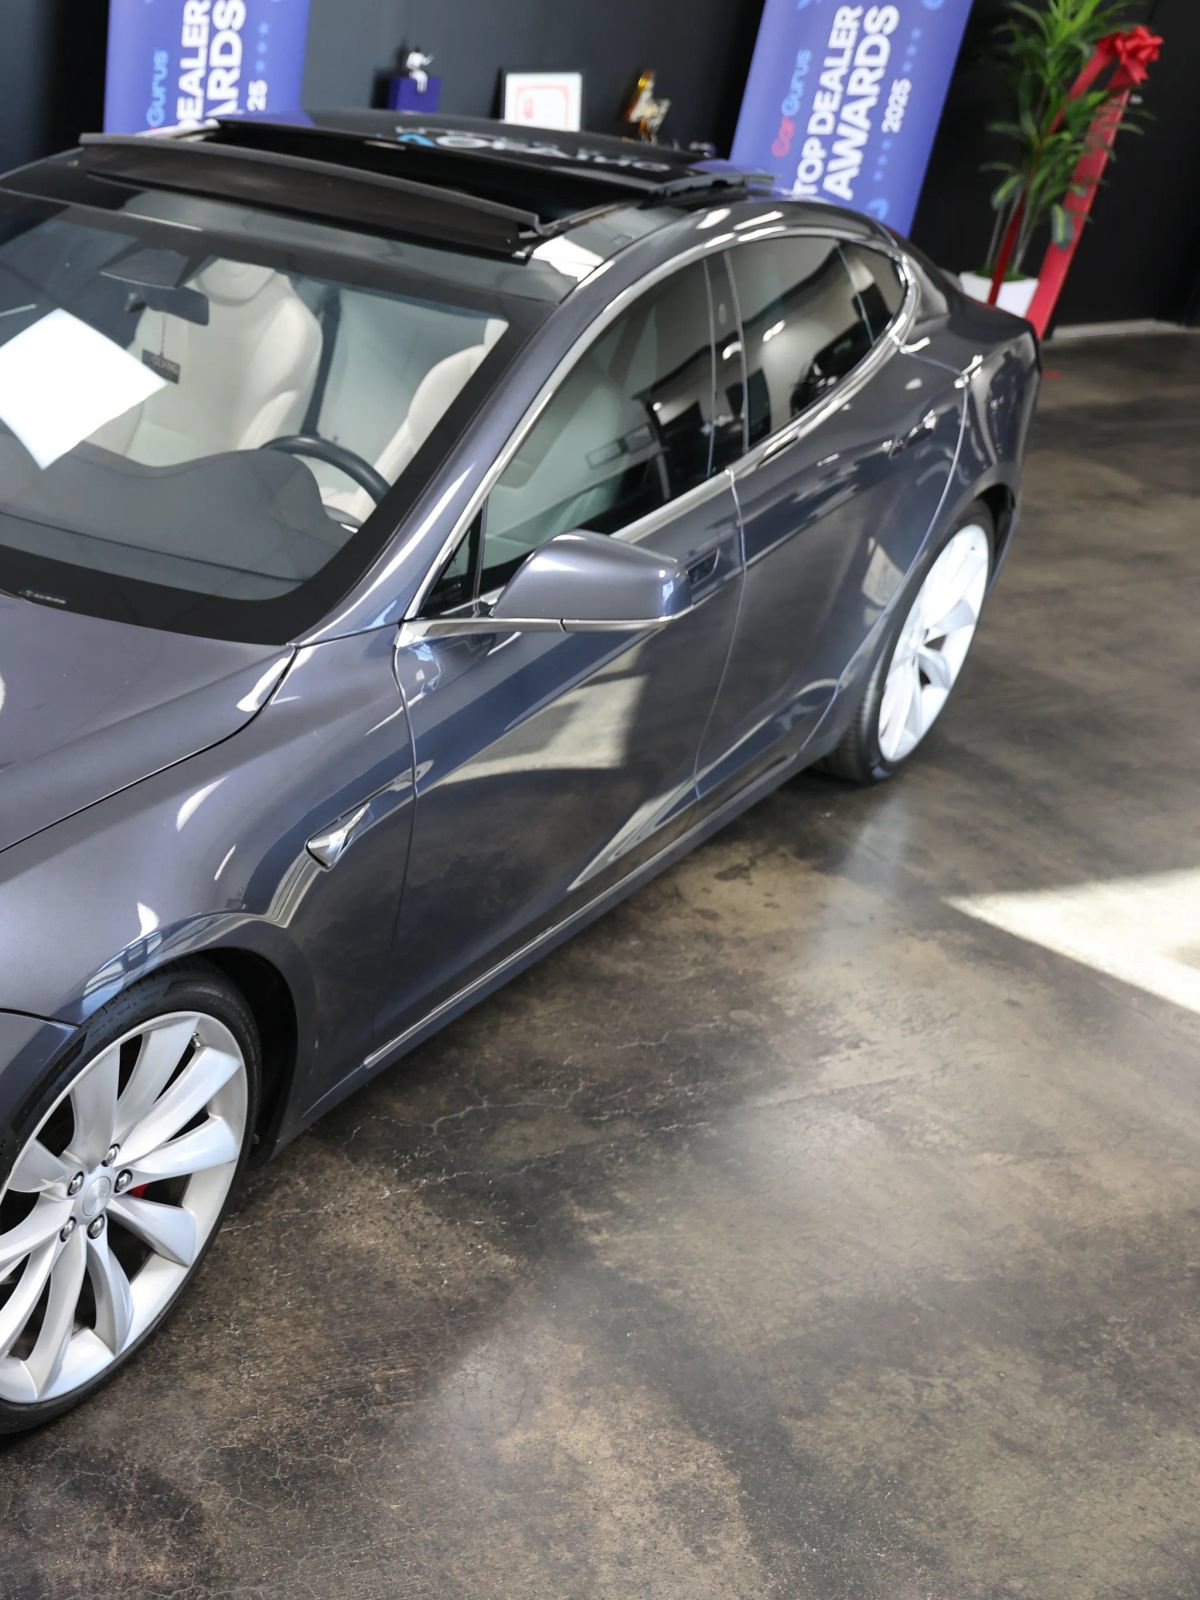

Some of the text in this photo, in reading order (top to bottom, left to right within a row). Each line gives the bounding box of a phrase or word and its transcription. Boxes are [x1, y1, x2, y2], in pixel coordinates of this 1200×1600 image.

[771, 50, 812, 157] CarGurus
[793, 5, 864, 196] TOP DEALER
[822, 4, 900, 200] AWARDS
[881, 78, 912, 133] 2025
